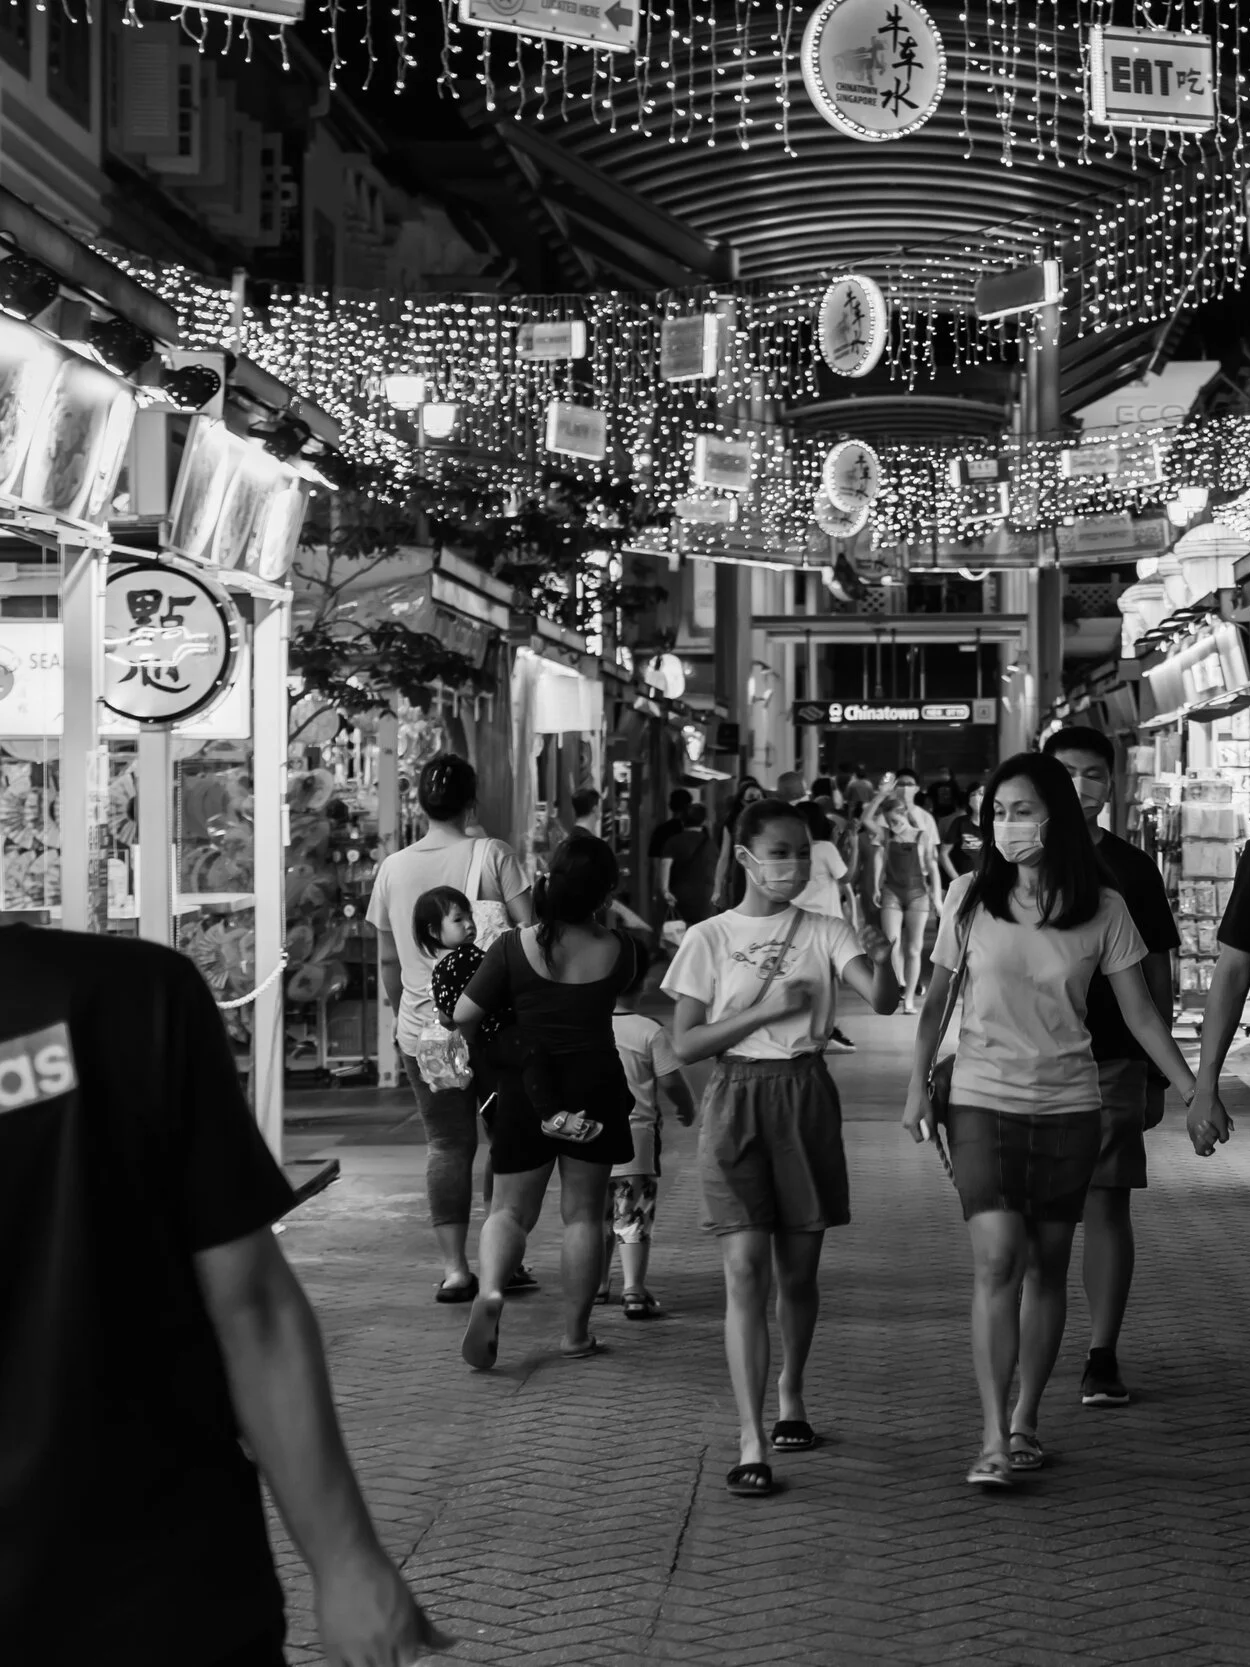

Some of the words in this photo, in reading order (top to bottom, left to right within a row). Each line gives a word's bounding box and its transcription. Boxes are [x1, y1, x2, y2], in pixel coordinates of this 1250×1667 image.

[1111, 55, 1174, 97] EAT
[836, 82, 878, 95] CHINATOWN
[836, 93, 877, 107] SINGAPORE
[843, 704, 920, 721] Chinatown
